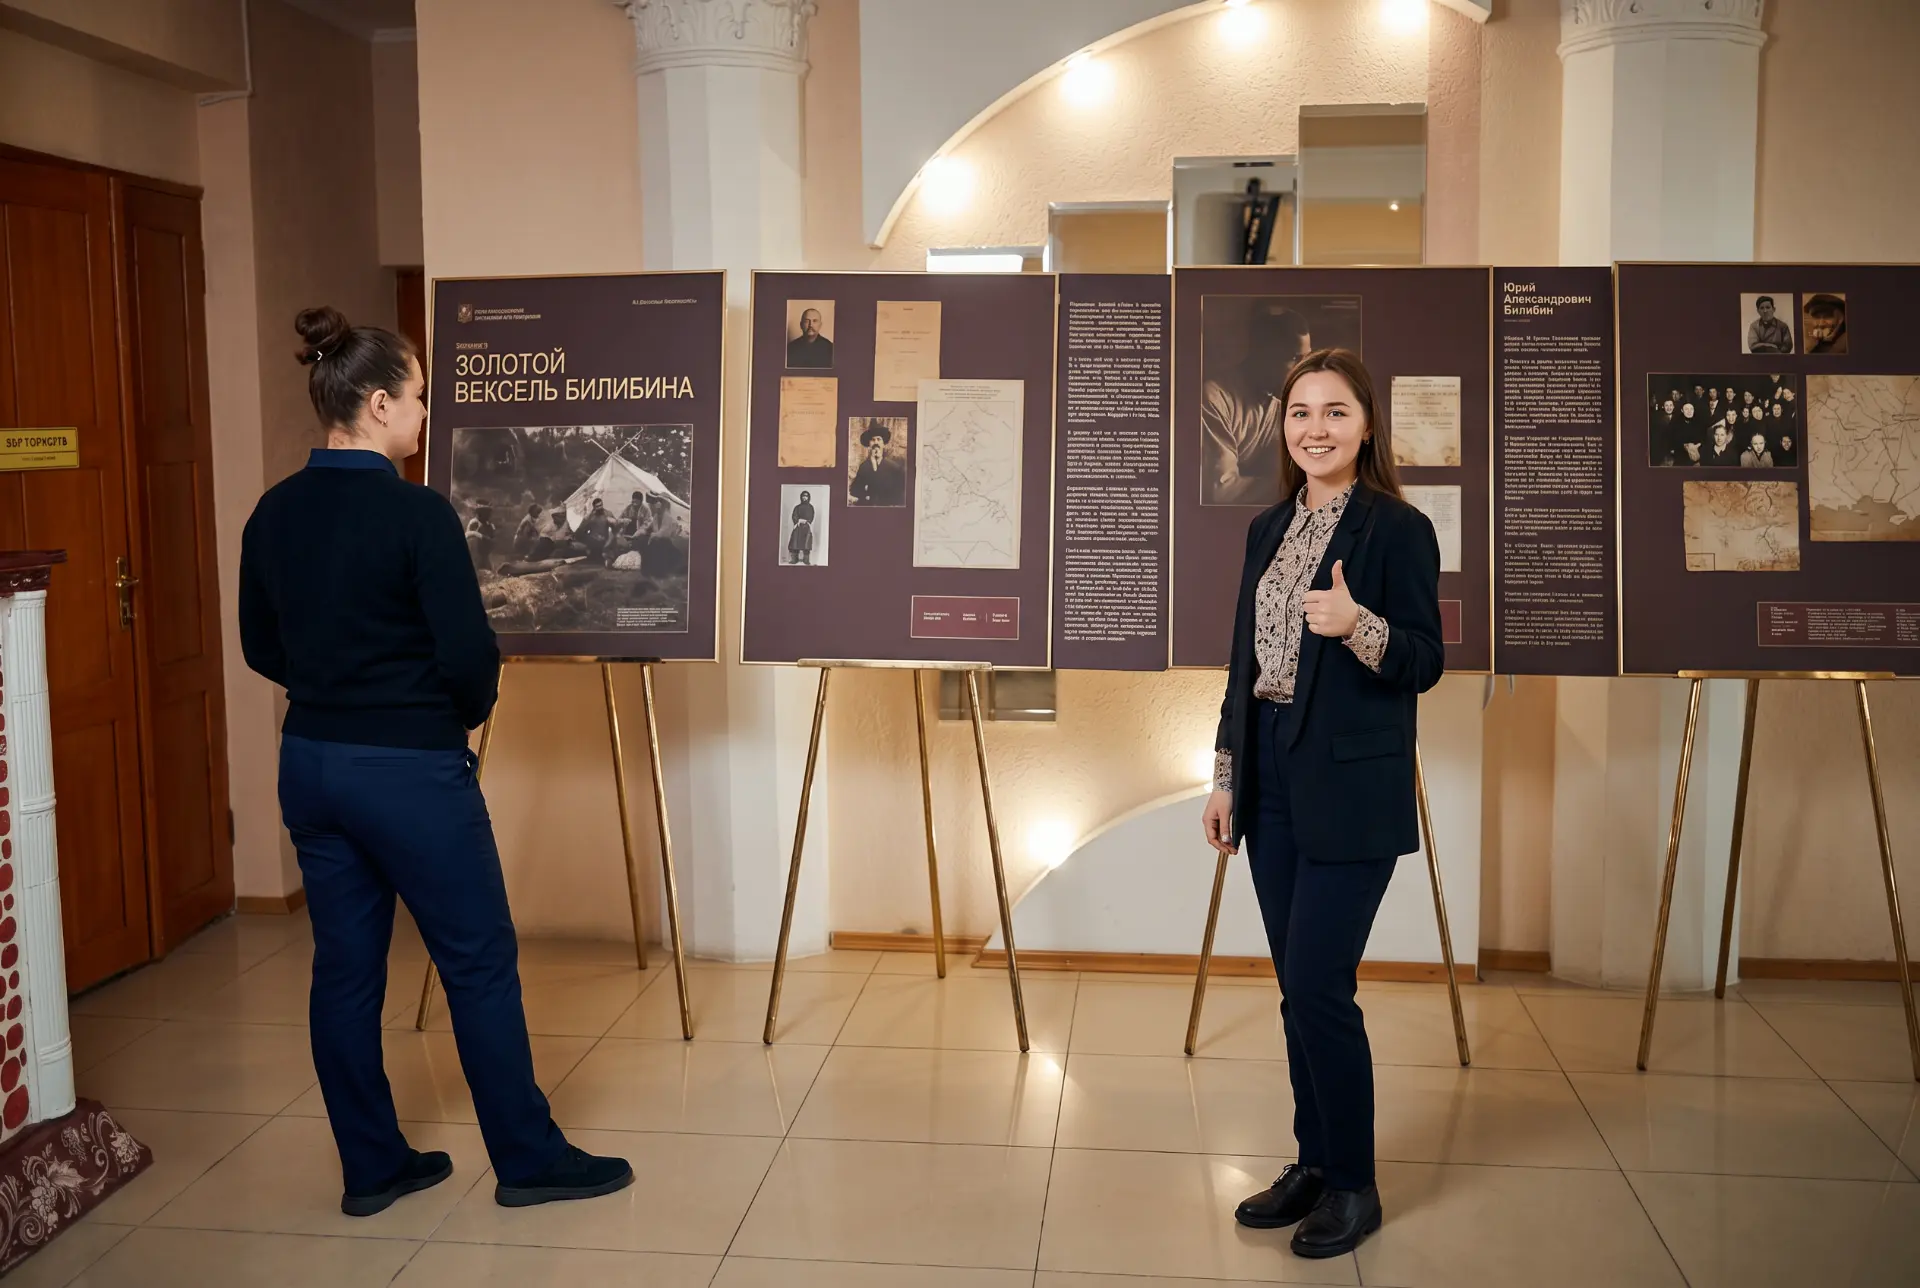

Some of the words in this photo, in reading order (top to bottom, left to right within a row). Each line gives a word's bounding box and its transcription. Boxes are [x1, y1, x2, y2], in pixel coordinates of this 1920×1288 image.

[1503, 282, 1536, 293] Юрий
[1503, 294, 1592, 306] Александрович
[1503, 305, 1554, 315] Билибин
[455, 347, 565, 376] ЗОЛОТОЙ
[455, 379, 559, 403] ВЕКСЕЛЬ
[565, 376, 695, 401] БИЛИБИНА
